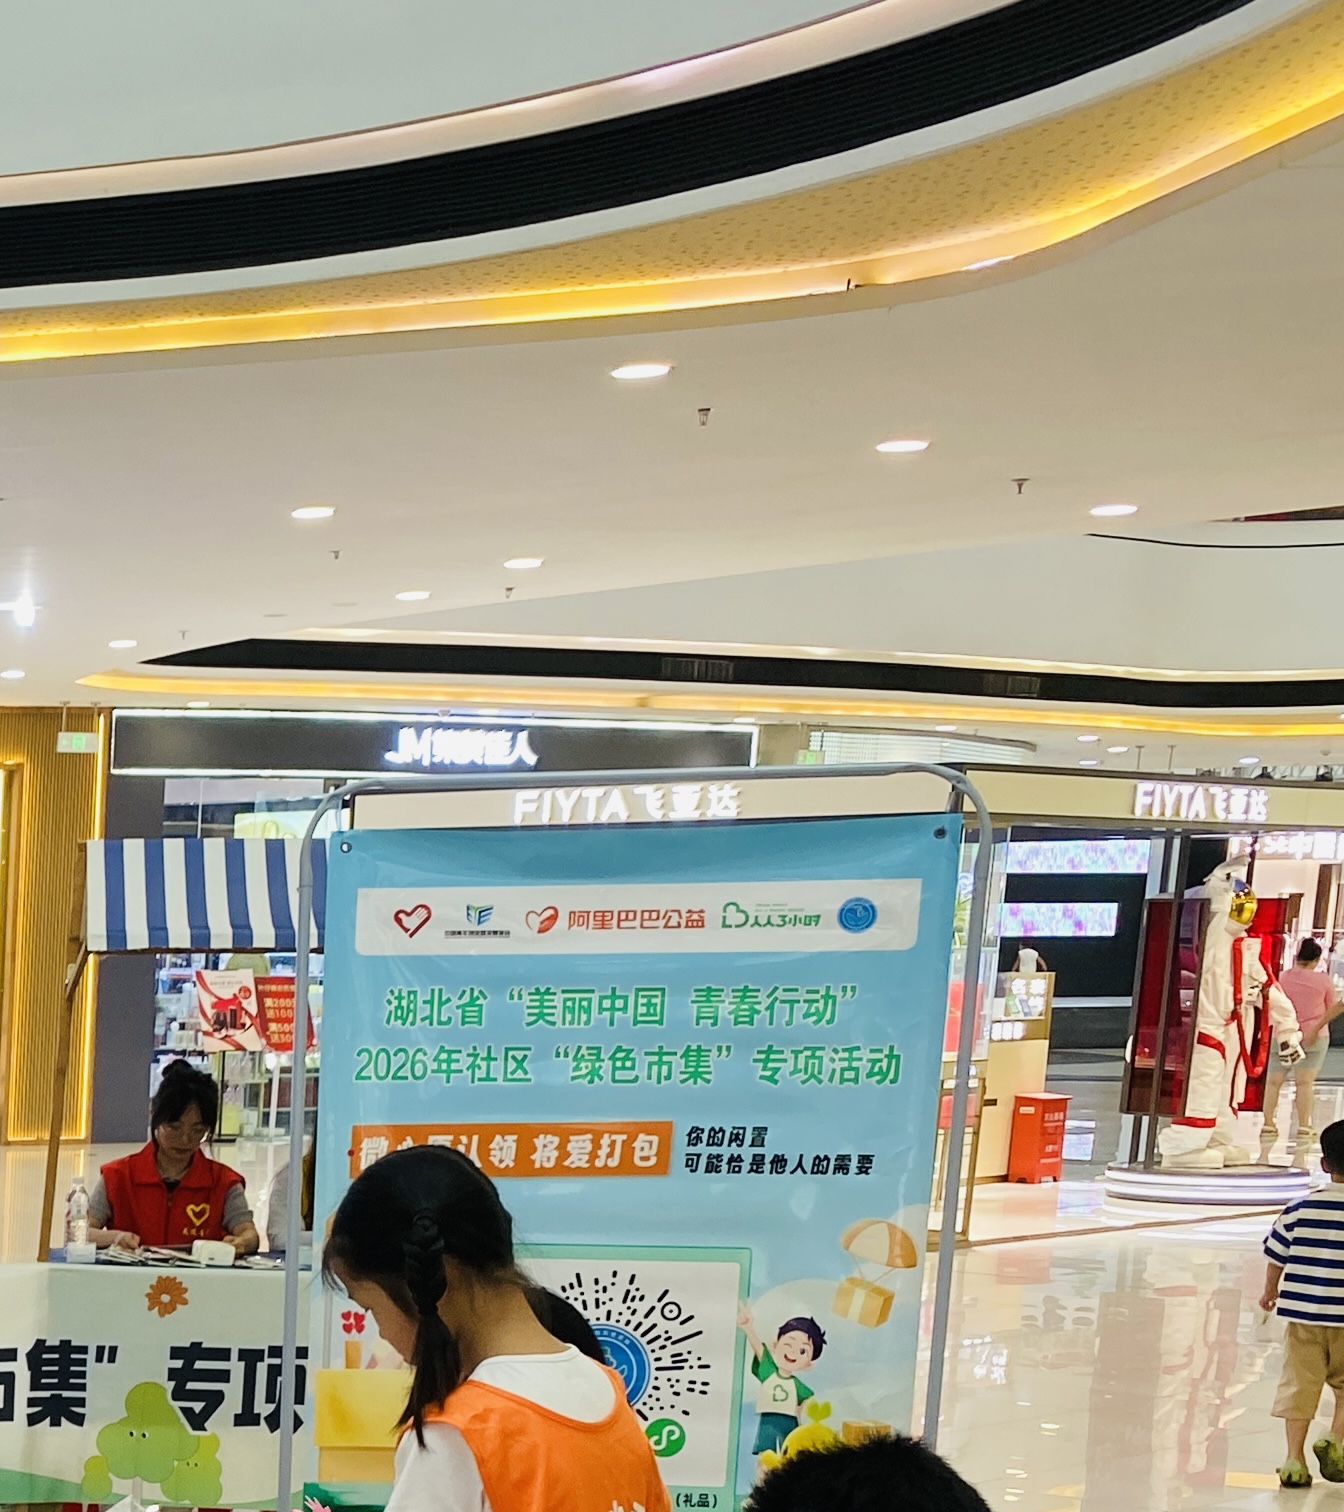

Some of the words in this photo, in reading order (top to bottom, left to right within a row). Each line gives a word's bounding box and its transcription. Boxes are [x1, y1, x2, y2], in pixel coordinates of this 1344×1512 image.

[513, 787, 630, 825] FIYTA
[633, 783, 742, 819] 飞亚达
[1134, 783, 1207, 820] FIYTA
[567, 908, 706, 931] 阿里巴巴公益
[384, 986, 489, 1028] 湖北省
[507, 986, 667, 1028] “美丽中国
[690, 984, 858, 1028] 青春行动”
[354, 1045, 534, 1085] 2026年社区
[553, 1044, 733, 1086] “绿色市集”
[751, 1043, 903, 1086] 专项活动
[529, 1132, 662, 1169] 将爱打包
[684, 1125, 769, 1148] 你的闲置
[683, 1152, 876, 1177] 可能恰是他人的需要
[166, 1340, 309, 1434] 专项
